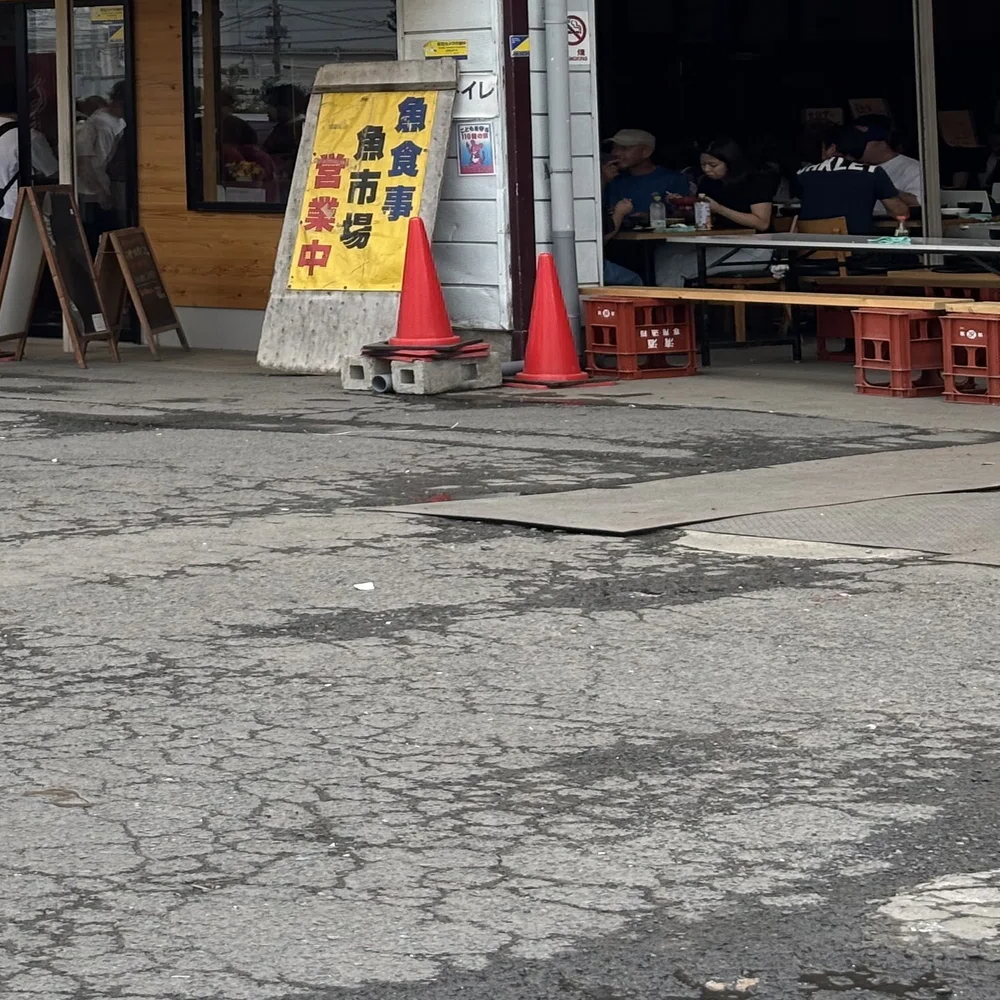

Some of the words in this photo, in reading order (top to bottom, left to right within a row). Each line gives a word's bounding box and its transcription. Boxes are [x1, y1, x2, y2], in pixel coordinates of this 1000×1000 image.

[456, 81, 495, 100] イレ
[297, 152, 347, 276] 営業中
[340, 125, 386, 249] 魚市場
[381, 96, 427, 222] 魚食事
